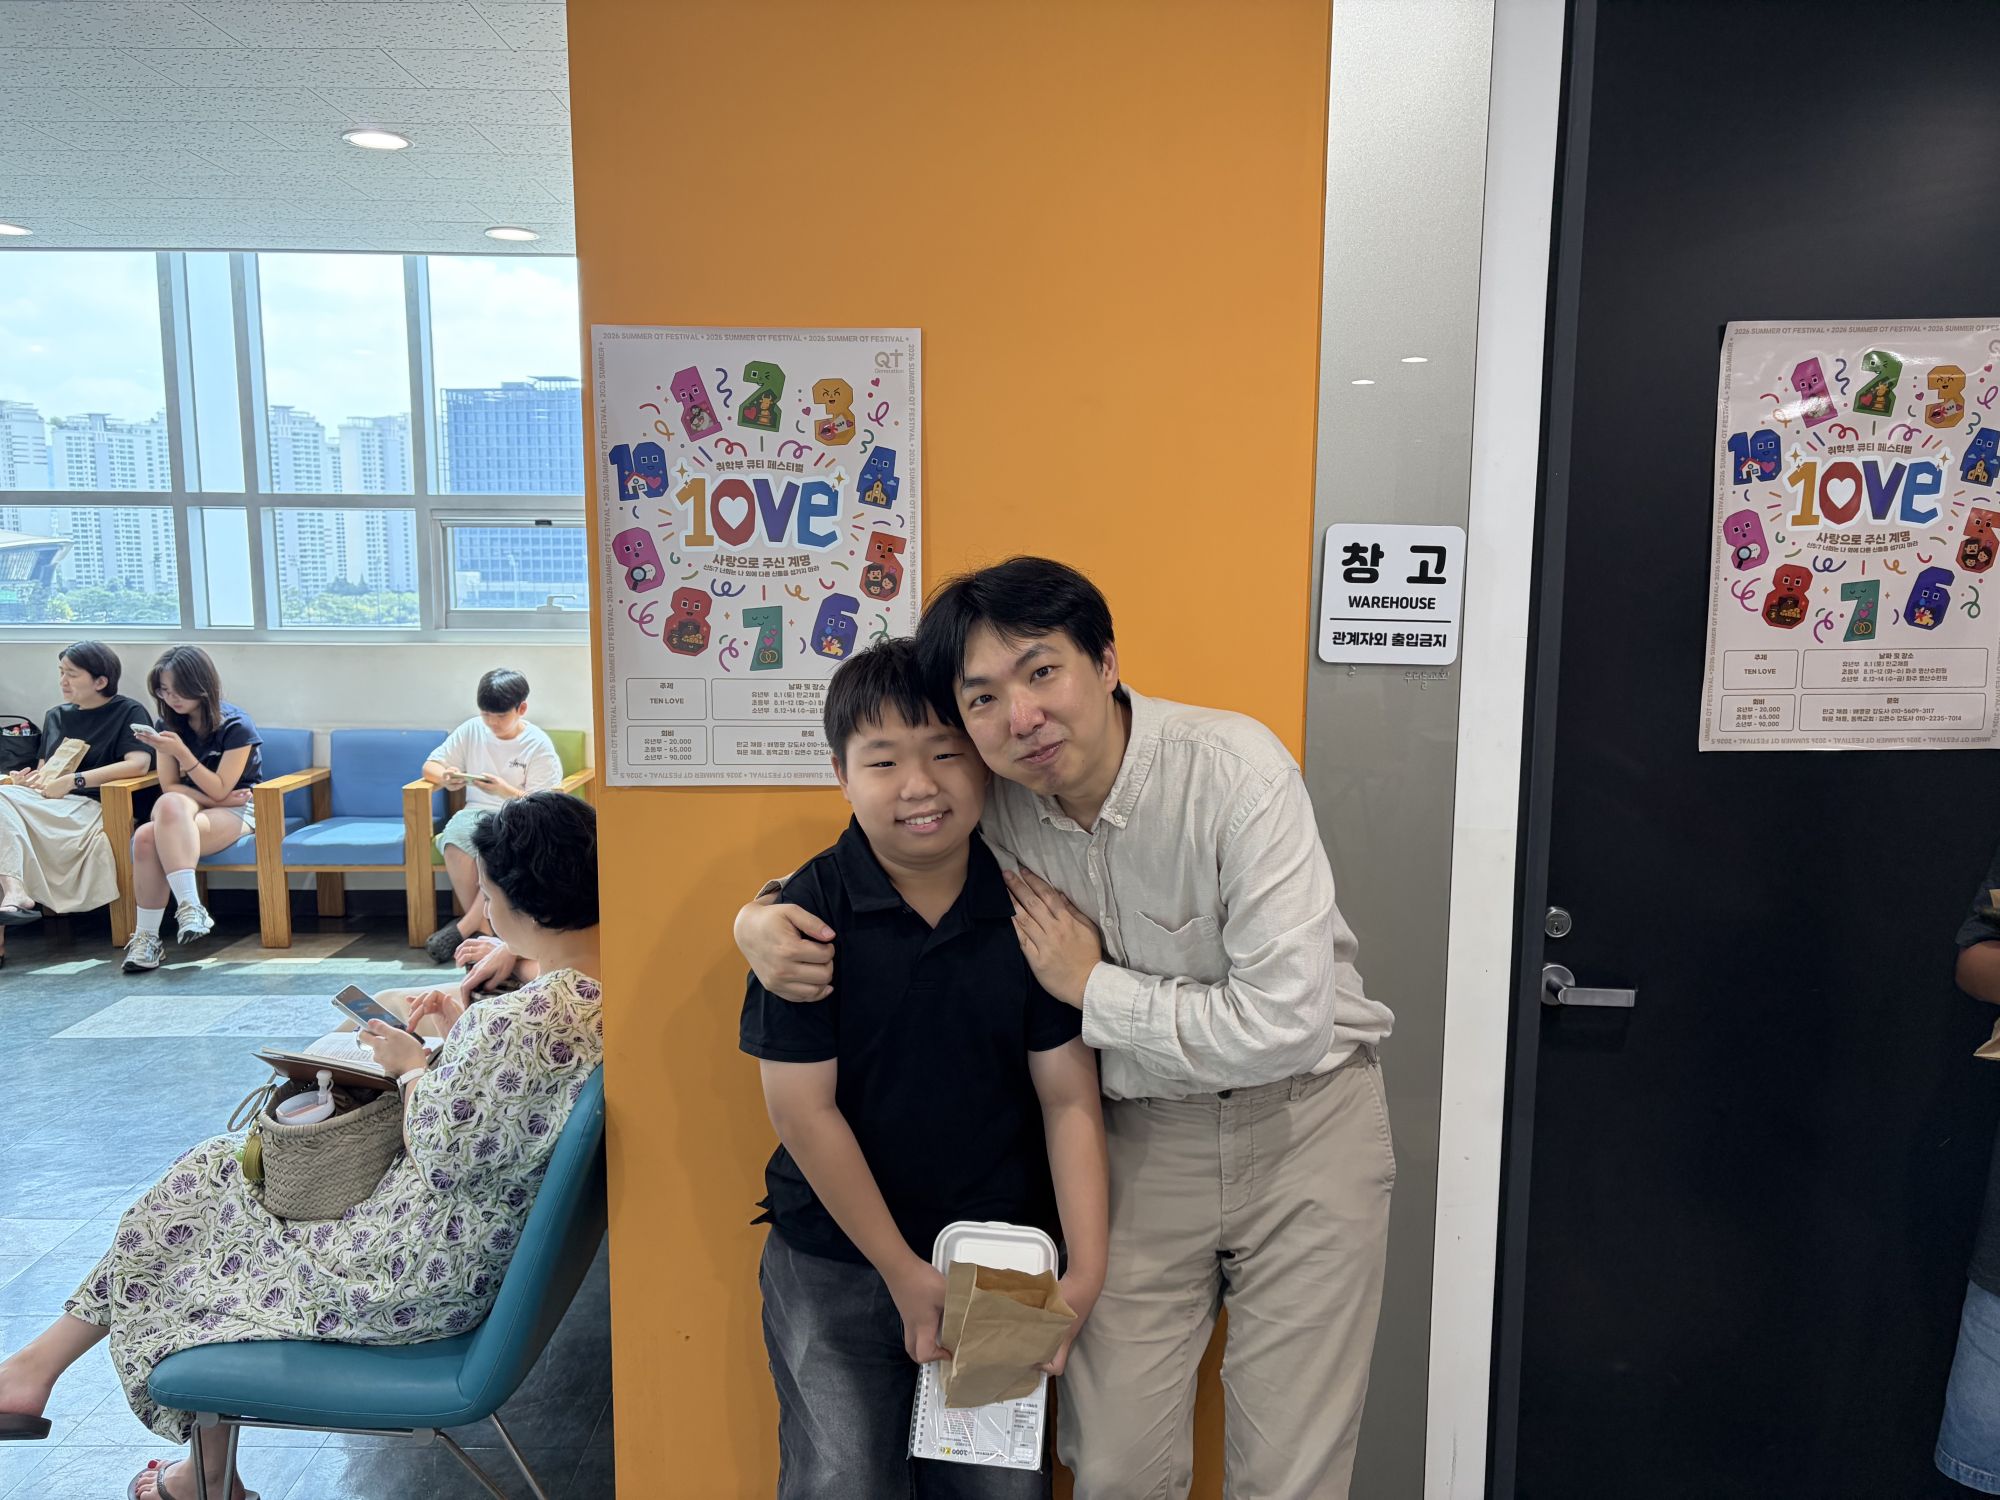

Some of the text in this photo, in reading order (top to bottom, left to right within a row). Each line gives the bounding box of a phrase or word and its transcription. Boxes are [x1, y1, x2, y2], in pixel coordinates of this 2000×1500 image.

[757, 334, 767, 342] QT
[670, 366, 722, 442] 1
[737, 360, 786, 432] 2
[812, 378, 856, 446] 3
[609, 441, 669, 501] 10
[716, 460, 804, 474] 취학부 큐티 페스티벌
[856, 446, 900, 510] 4
[612, 527, 665, 593] 9
[712, 554, 812, 569] 사랑으로 주신 계명
[859, 531, 907, 601] 5
[1816, 531, 1911, 545] 사랑으로 주신 계명
[663, 587, 712, 656] 8
[810, 593, 860, 660] 6
[1348, 595, 1436, 610] WAREHOUSE
[742, 606, 783, 671] 7
[1332, 631, 1447, 647] 관계자외 출입금지
[649, 697, 685, 705] TEN LOVE
